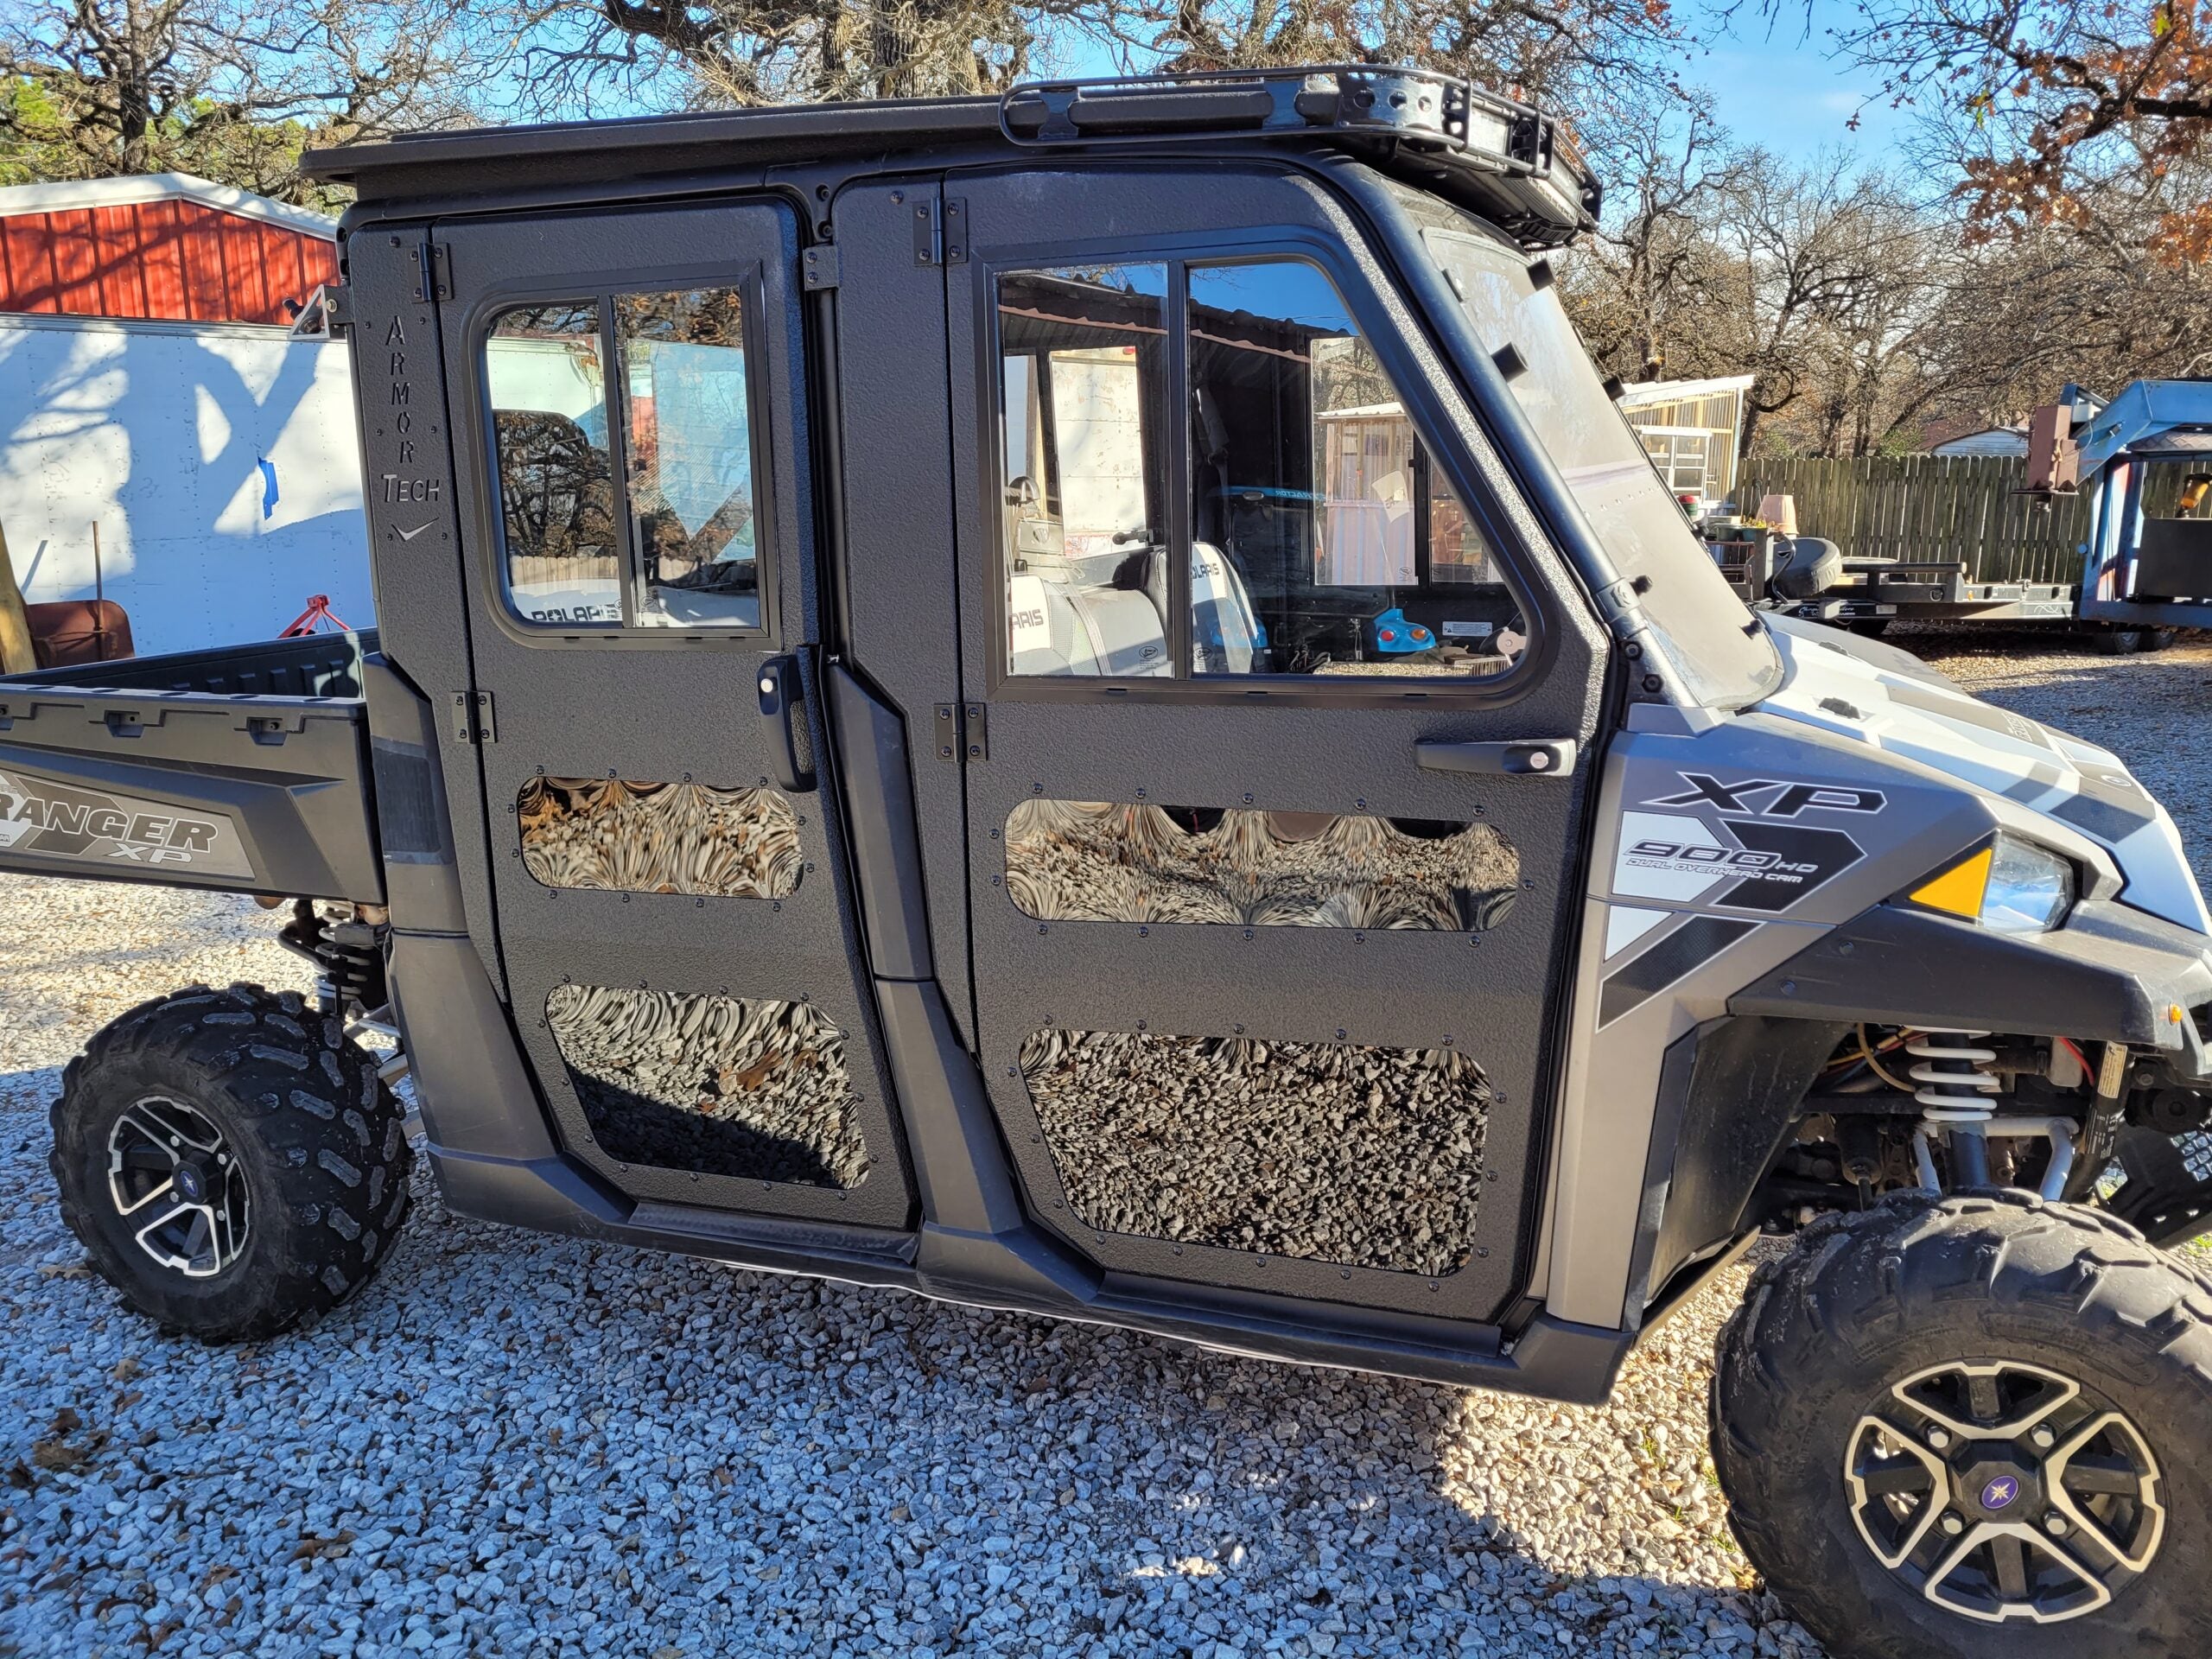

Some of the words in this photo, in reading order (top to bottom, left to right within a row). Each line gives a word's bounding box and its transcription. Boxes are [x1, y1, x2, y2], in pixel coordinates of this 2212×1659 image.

[385, 315, 414, 464] ARMOR
[1192, 563, 1220, 580] OLARIS
[1012, 608, 1044, 630] ARIS
[1639, 772, 1887, 817] XP
[104, 842, 193, 863] XP
[1626, 858, 1673, 869] DUAL
[1675, 864, 1764, 880] OVERHEAD
[1764, 873, 1803, 883] CAM
